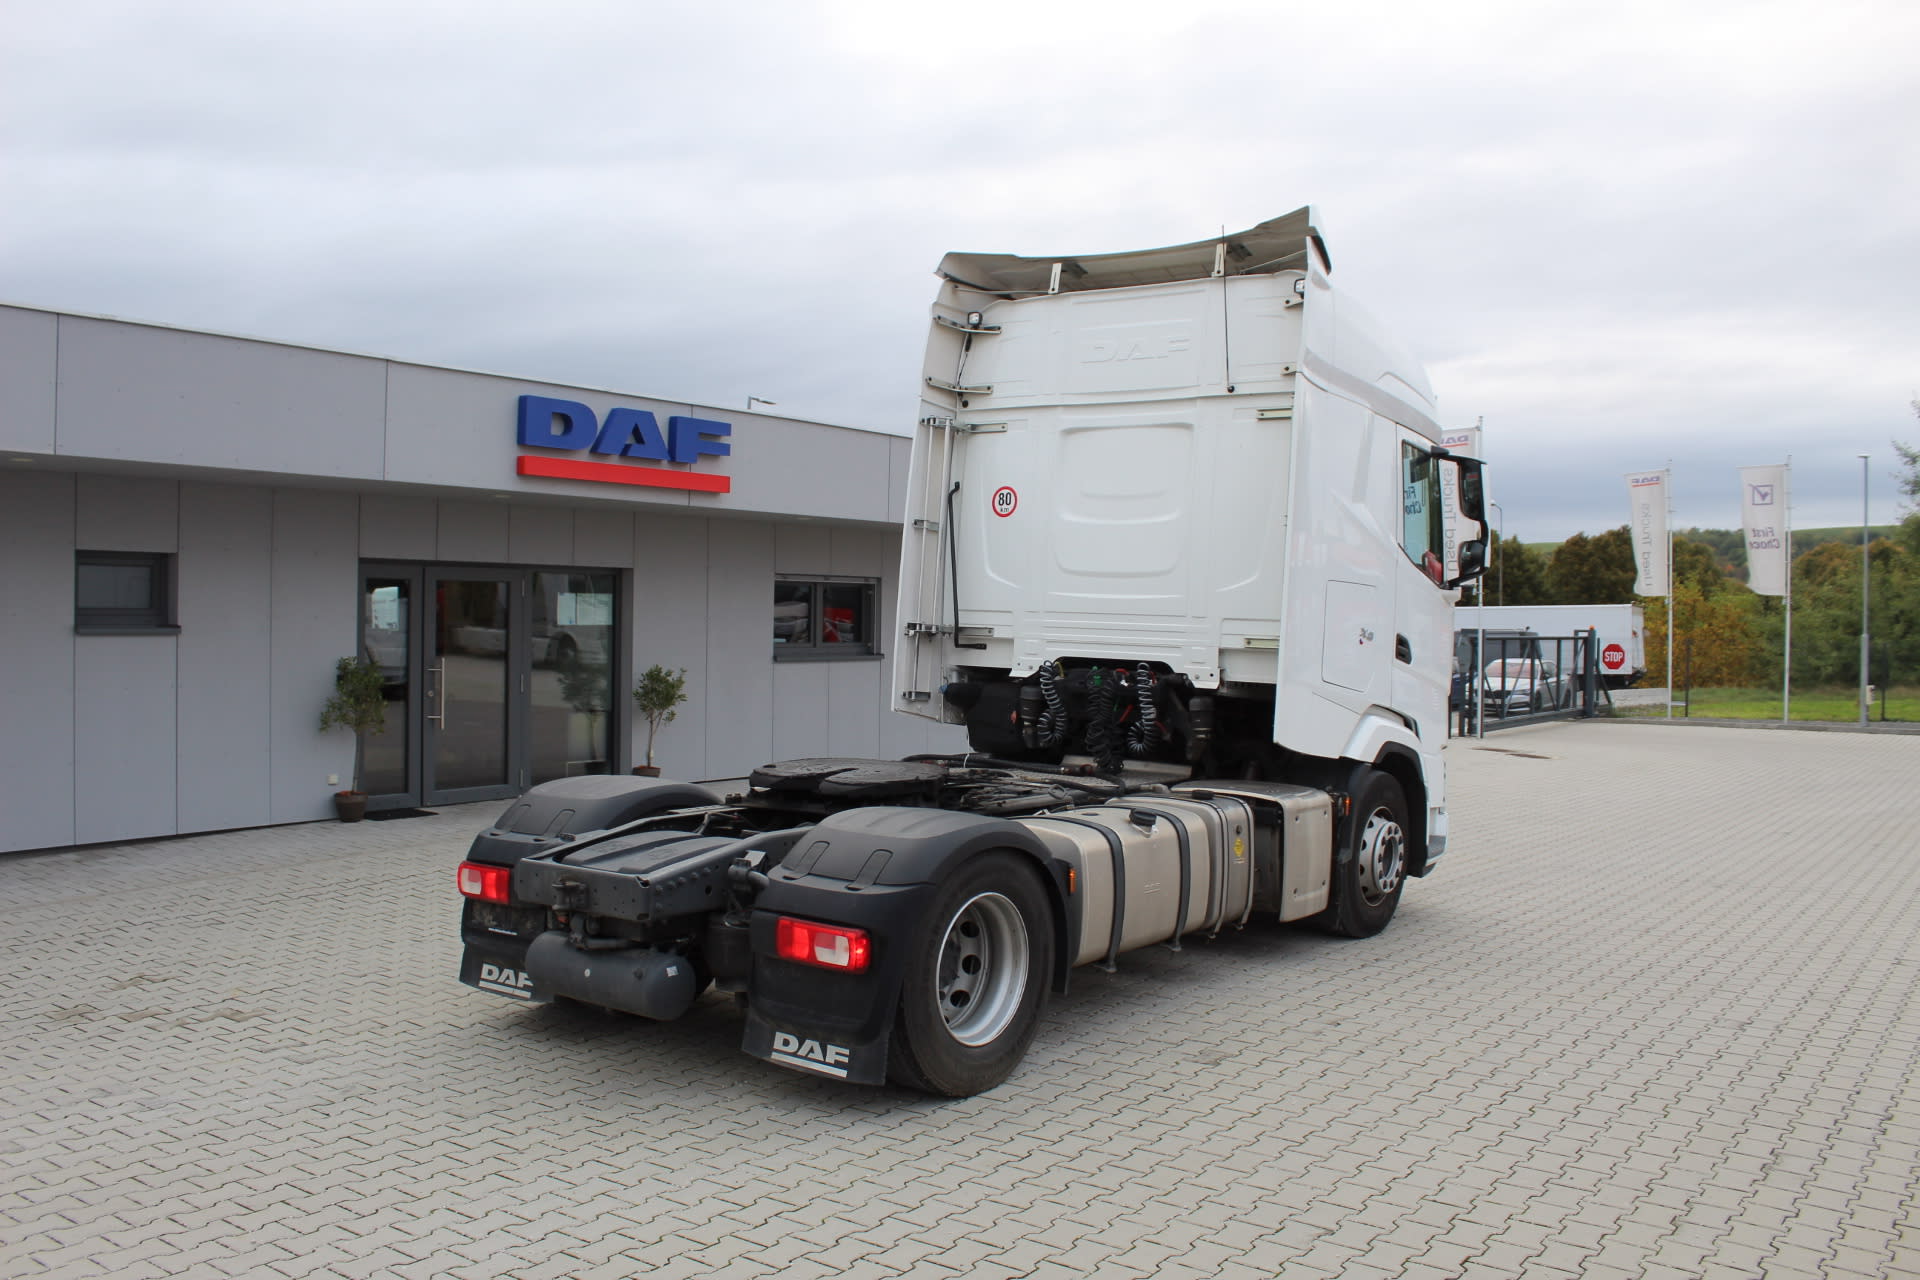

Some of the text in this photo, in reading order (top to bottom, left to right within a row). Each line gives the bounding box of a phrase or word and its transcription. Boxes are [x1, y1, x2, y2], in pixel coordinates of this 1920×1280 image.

[1080, 336, 1191, 363] DAF
[517, 395, 732, 464] DAF
[998, 492, 1011, 506] 80
[1604, 651, 1624, 662] STOP
[481, 963, 534, 988] DAF
[773, 1031, 850, 1065] DAF
